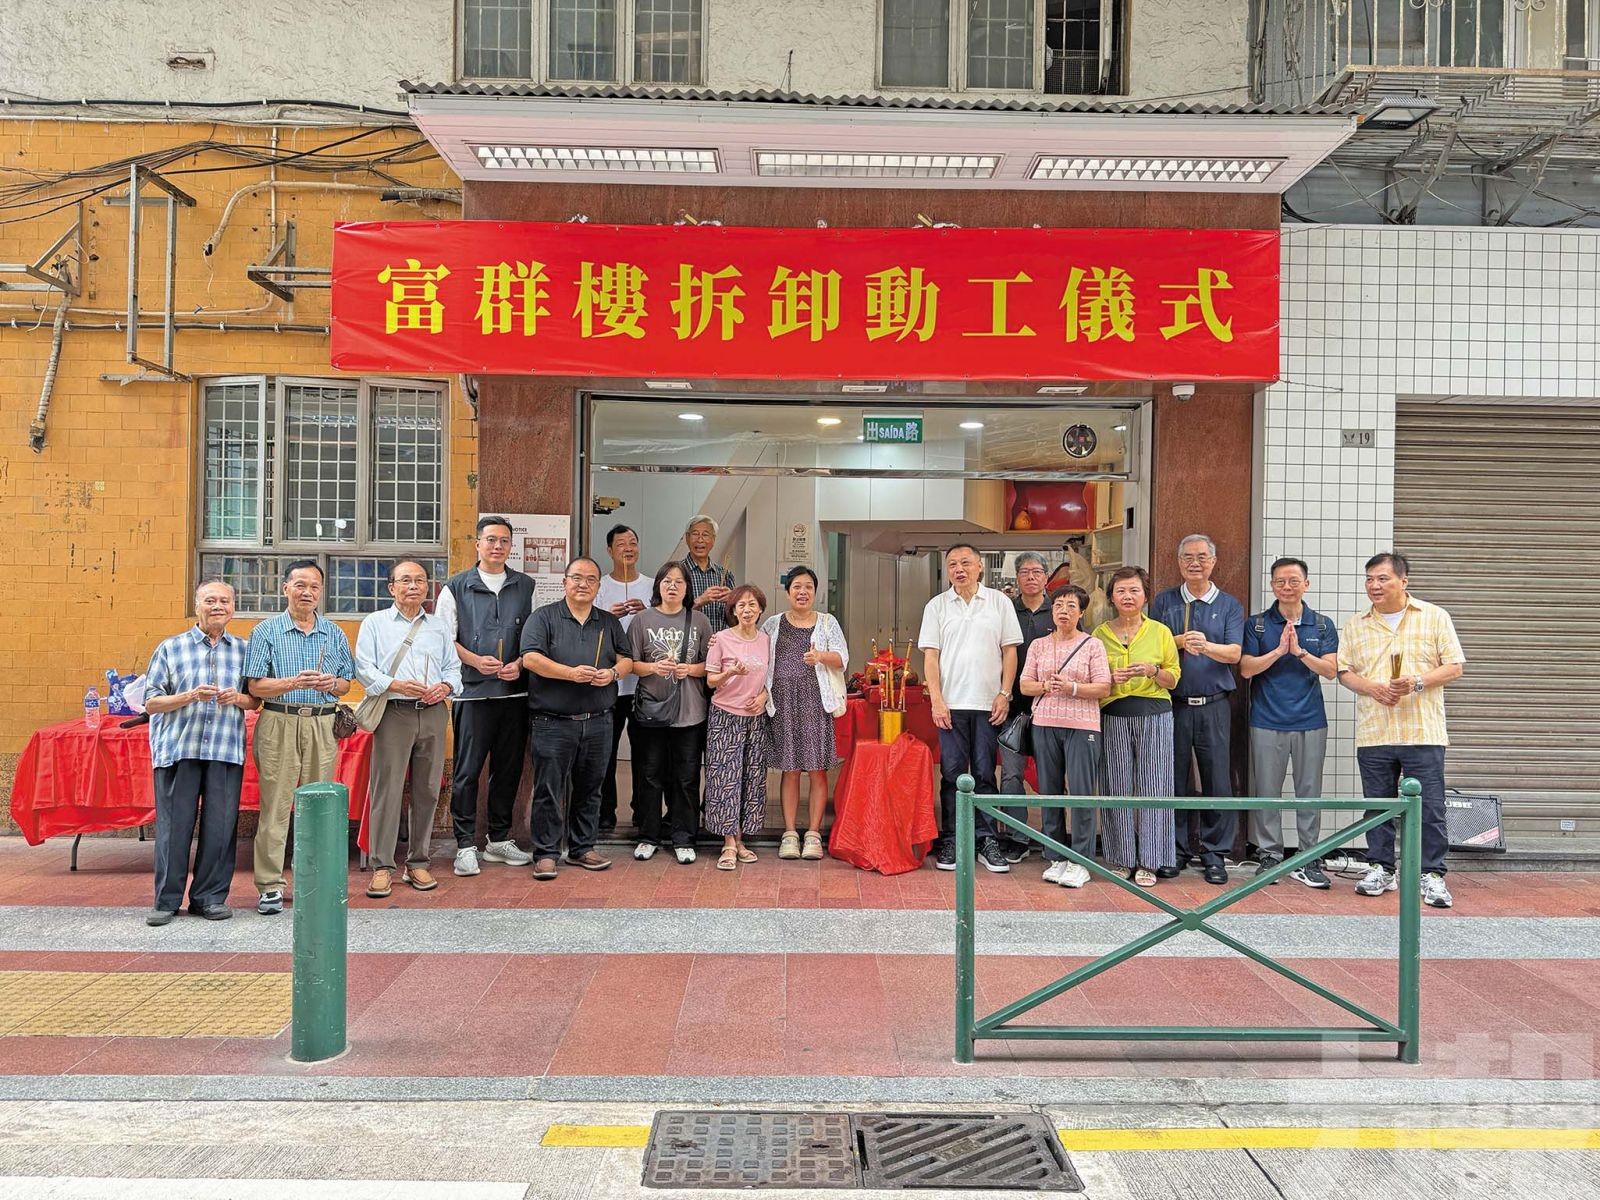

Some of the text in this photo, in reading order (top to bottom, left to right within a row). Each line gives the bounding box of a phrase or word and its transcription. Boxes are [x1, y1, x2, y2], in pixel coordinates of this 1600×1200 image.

[376, 258, 1236, 344] 富群樓拆卸動工儀式
[879, 425, 905, 439] SAÍDA
[1359, 432, 1370, 444] 19
[1444, 801, 1472, 809] UBE
